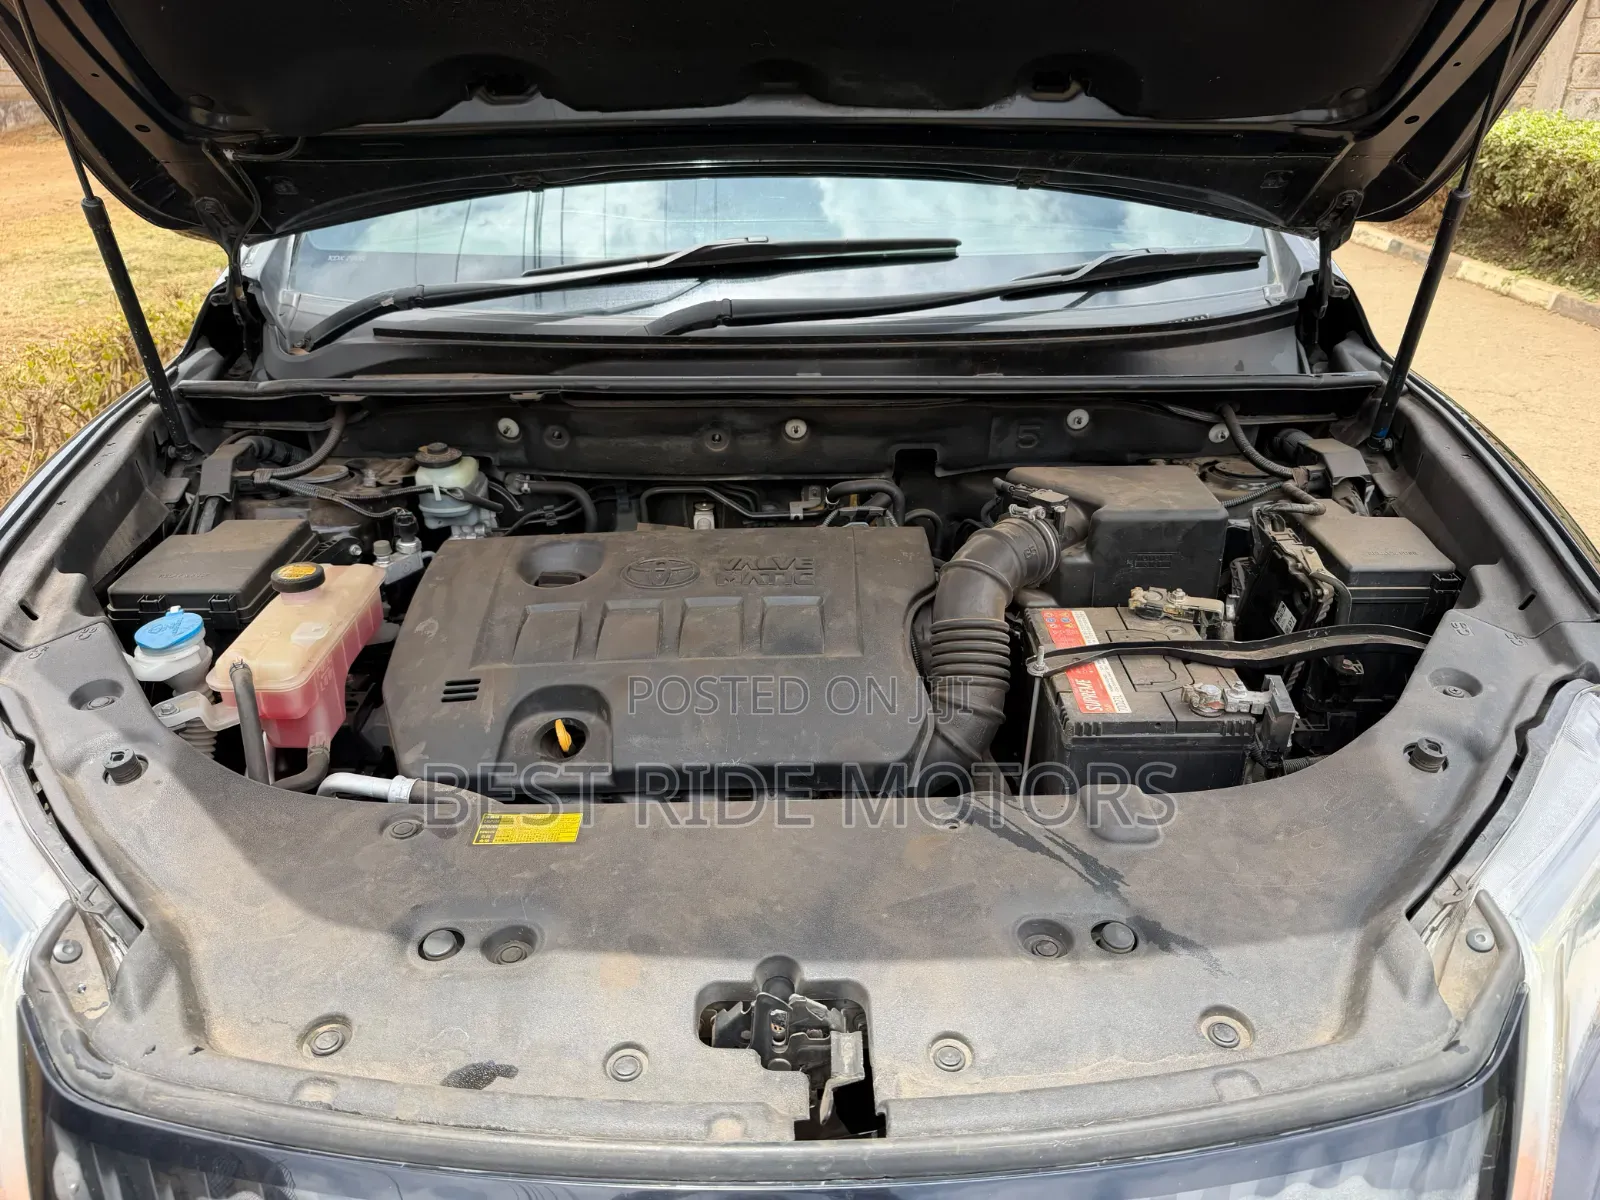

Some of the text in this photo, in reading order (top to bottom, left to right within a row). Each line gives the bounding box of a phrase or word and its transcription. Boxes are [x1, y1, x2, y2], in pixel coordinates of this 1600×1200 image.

[719, 556, 816, 571] VALVE
[715, 571, 816, 587] MATIC
[1075, 679, 1104, 712] SUPREME
